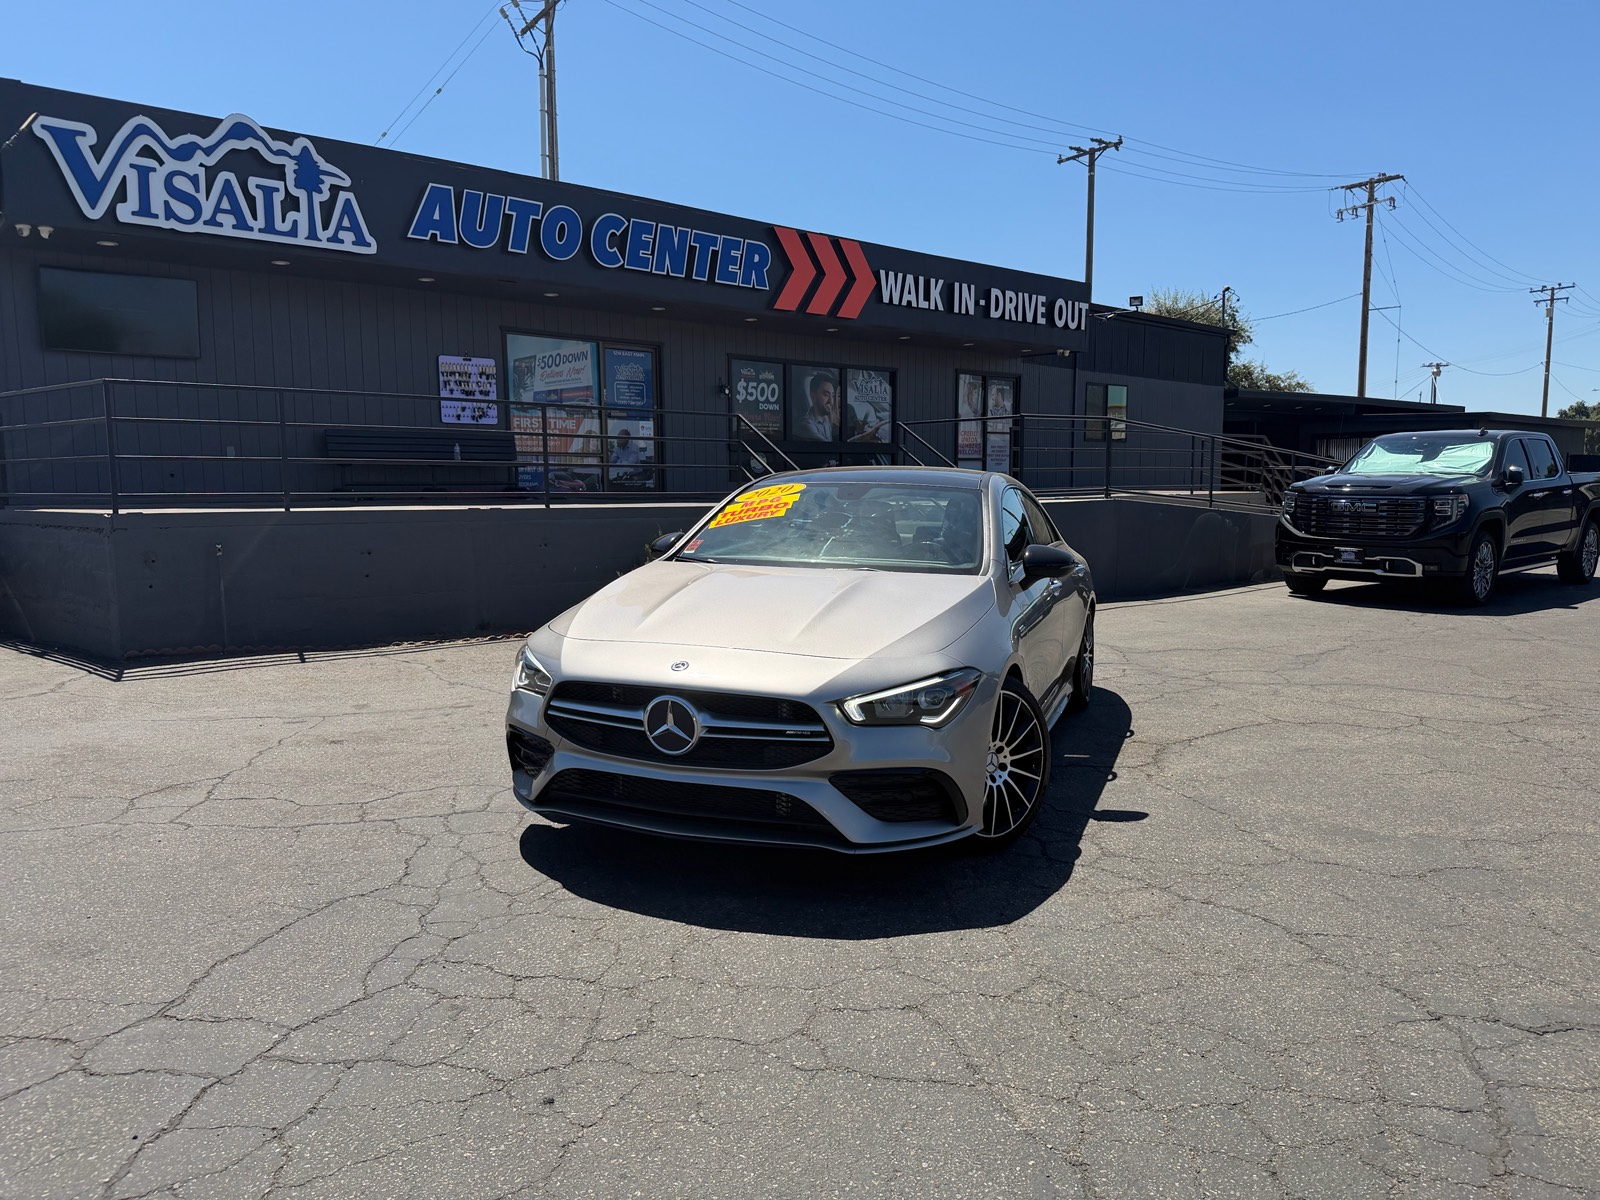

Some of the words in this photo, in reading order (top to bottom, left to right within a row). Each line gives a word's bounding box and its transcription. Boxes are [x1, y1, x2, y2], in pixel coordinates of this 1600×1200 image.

[32, 113, 377, 254] VISALIA
[407, 182, 583, 261] AUTO
[591, 213, 771, 291] CENTER
[879, 269, 944, 311] WALK
[953, 282, 975, 315] IN
[989, 287, 1047, 325] DRIVE
[1054, 297, 1089, 331] OUT
[537, 352, 562, 370] $500
[562, 350, 588, 365] DOWN
[736, 378, 779, 403] $500
[852, 377, 889, 395] VISALIA
[758, 403, 780, 411] DOWN
[549, 419, 576, 430] TIME
[745, 484, 795, 500] 2020
[720, 502, 790, 519] TURBO
[740, 496, 783, 508] MPG
[1330, 502, 1377, 513] GMC
[714, 509, 781, 526] LUXURY
